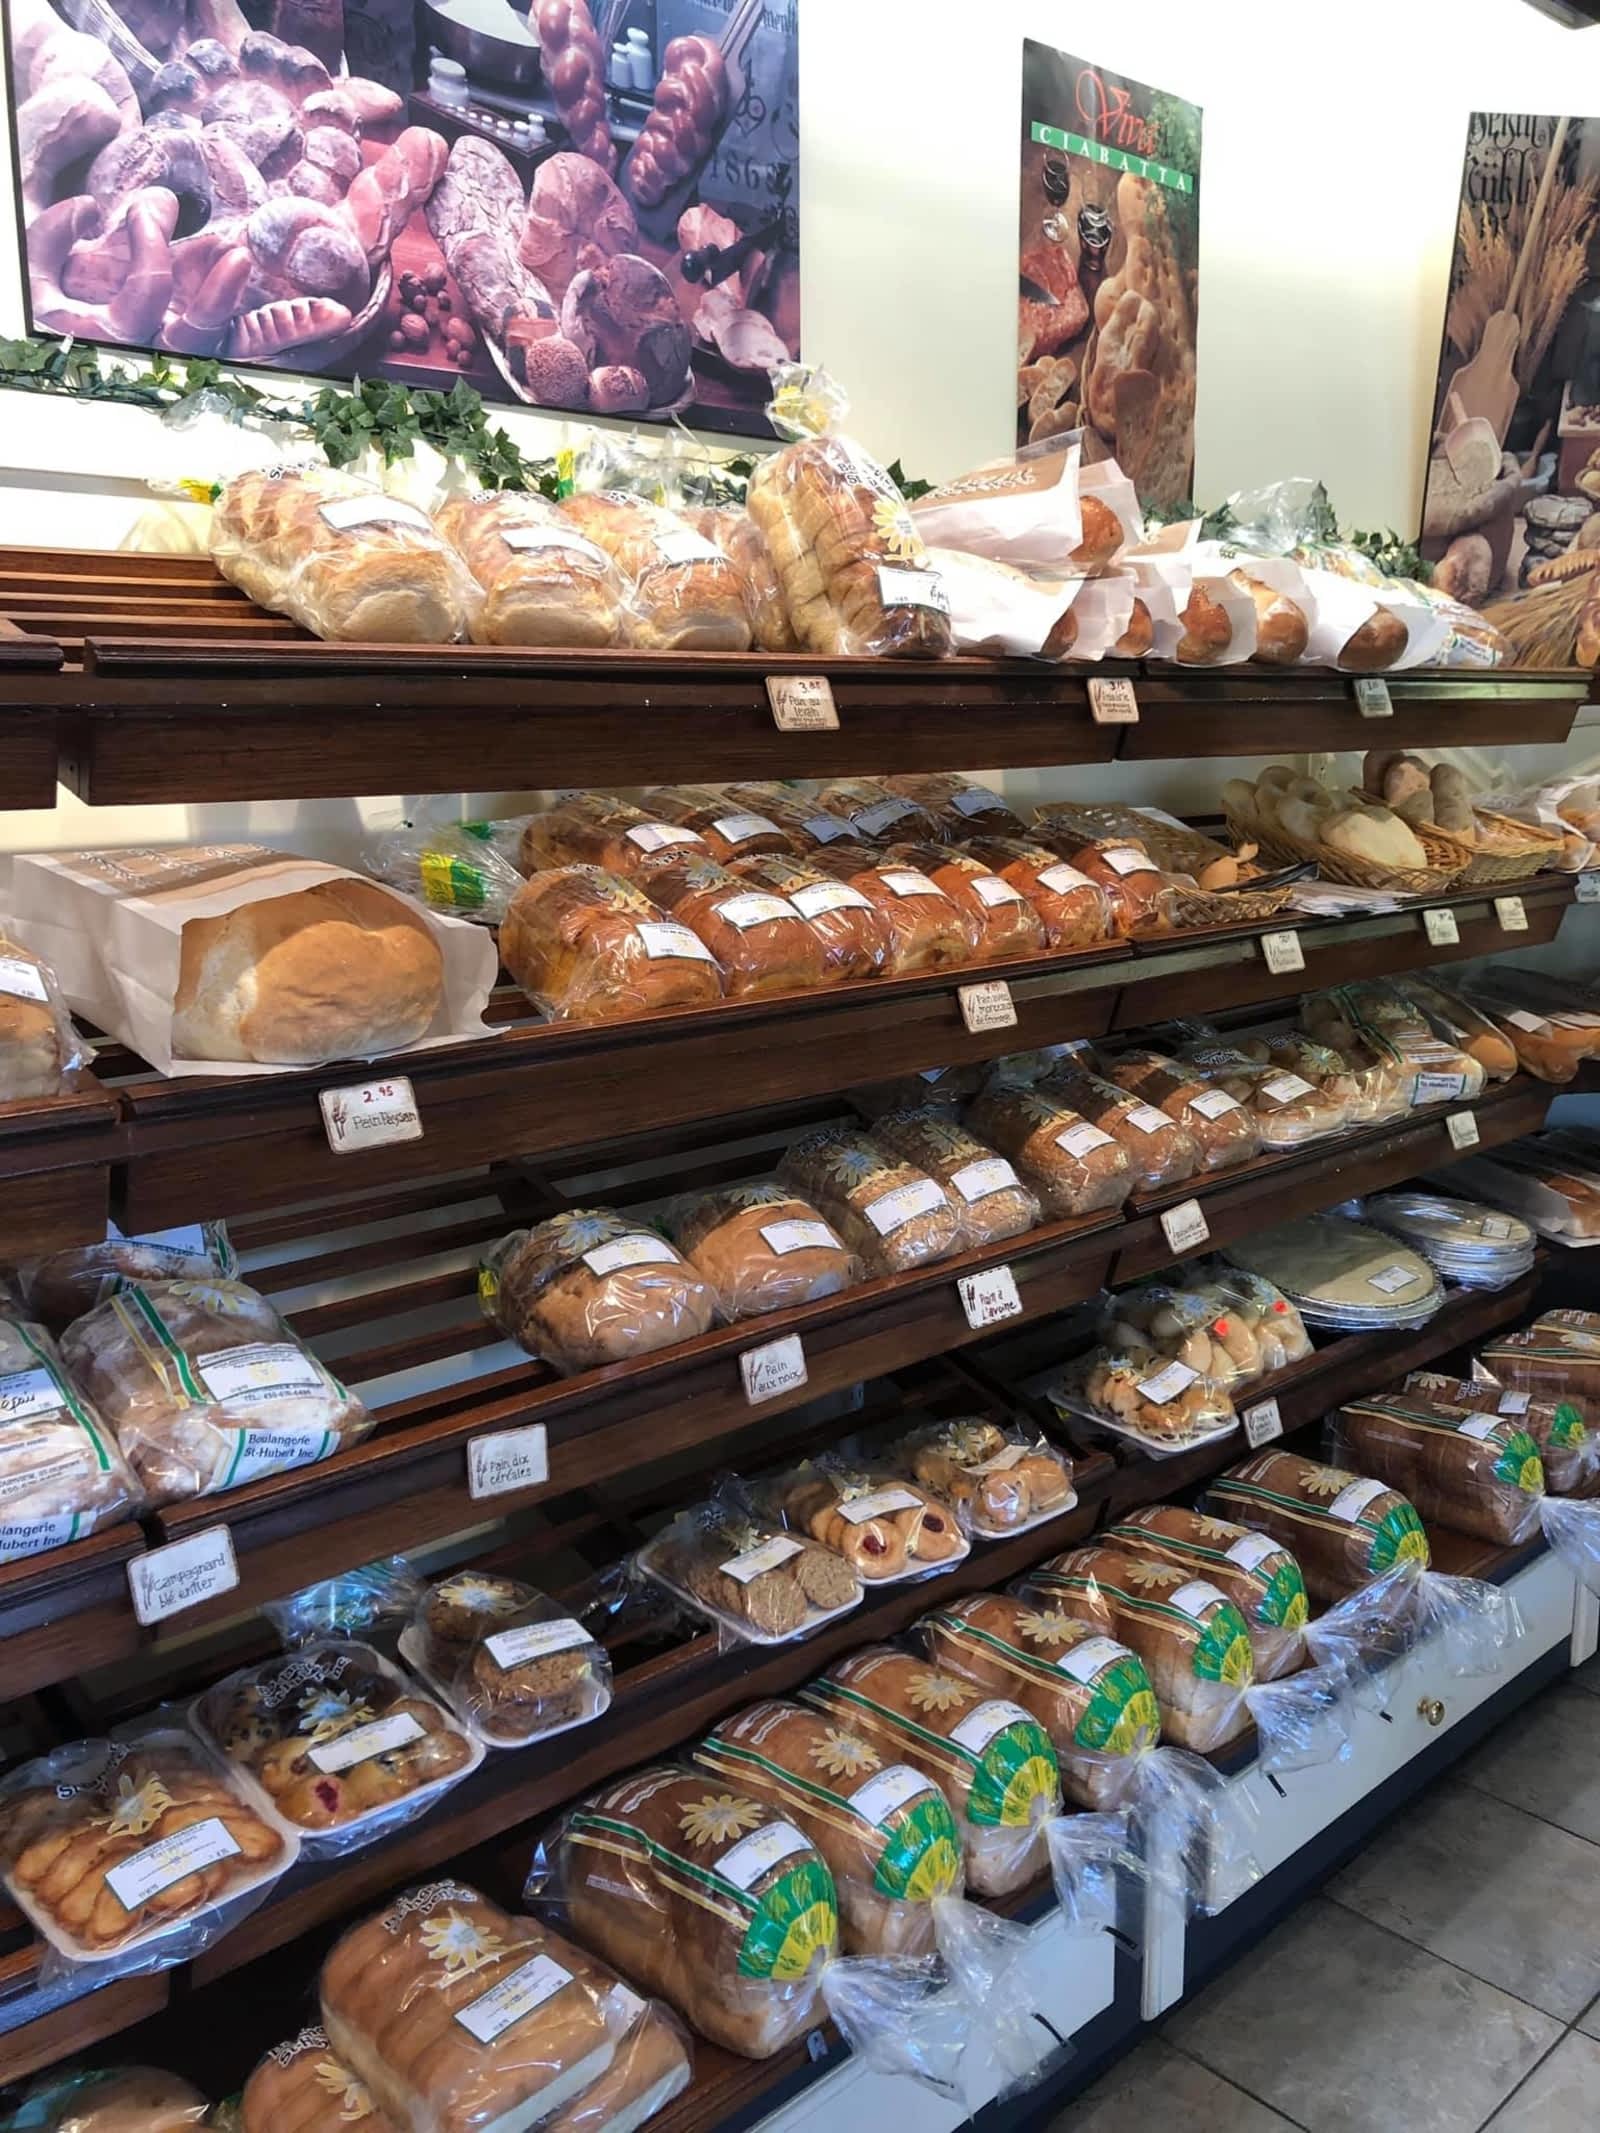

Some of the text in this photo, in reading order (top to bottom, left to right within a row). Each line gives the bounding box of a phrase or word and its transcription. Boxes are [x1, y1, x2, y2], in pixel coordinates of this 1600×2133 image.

[1039, 126, 1186, 192] CIABATTA
[362, 1085, 394, 1104] 2.95
[351, 1114, 379, 1130] Pain
[764, 1361, 788, 1377] Pain
[758, 1379, 777, 1393] aux
[248, 1432, 311, 1449] Boulangerie
[243, 1447, 295, 1459] St-Hubert
